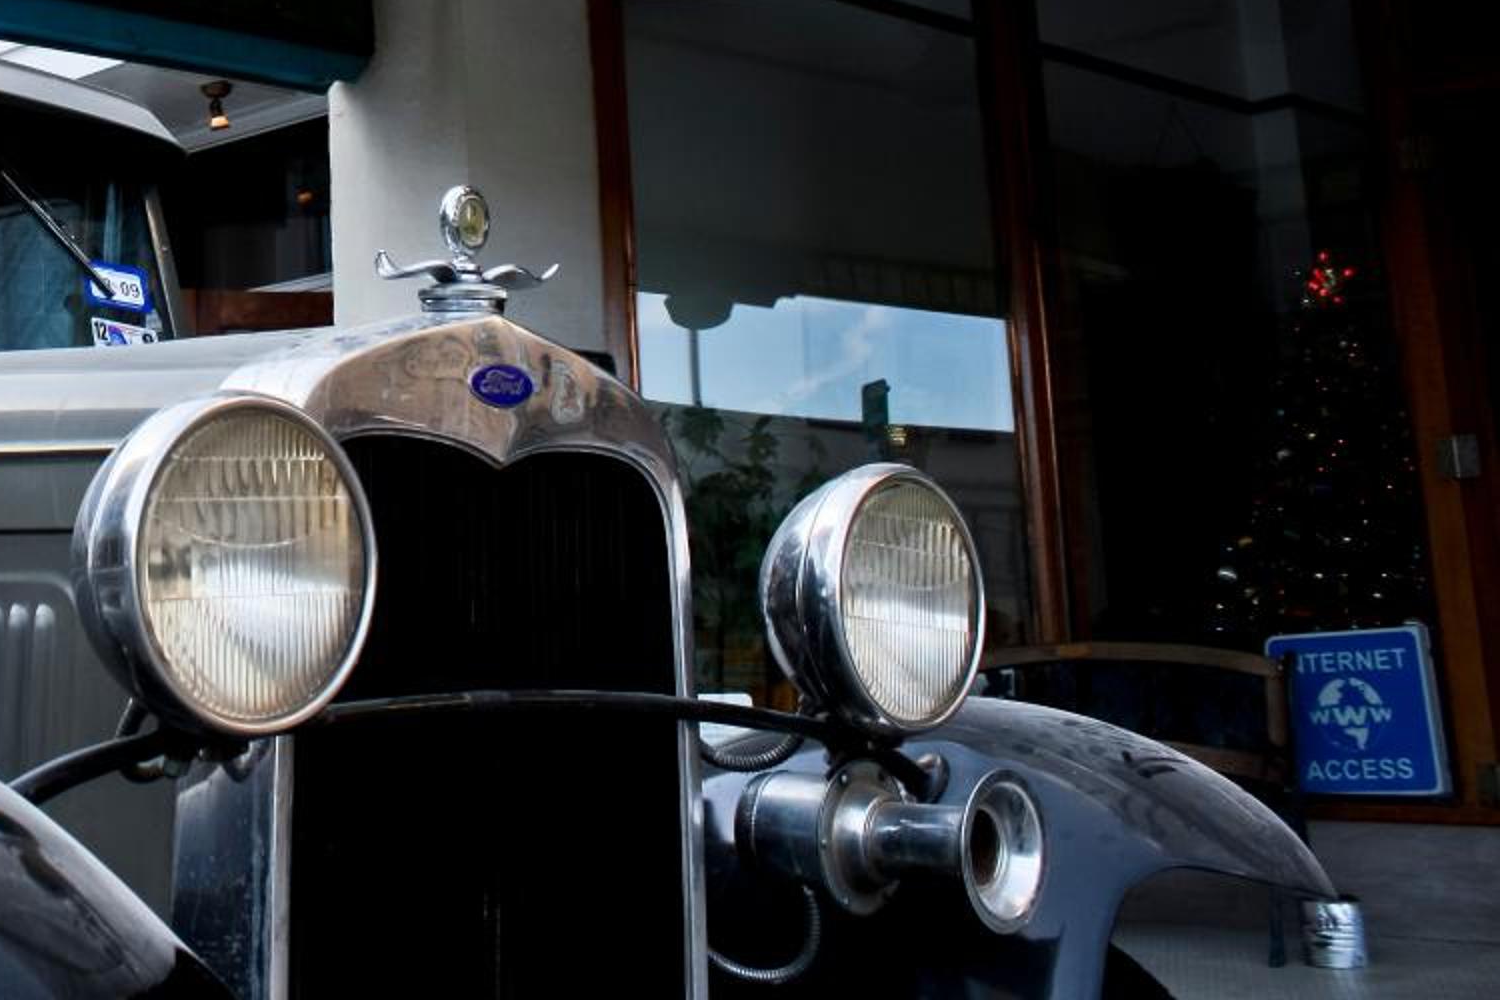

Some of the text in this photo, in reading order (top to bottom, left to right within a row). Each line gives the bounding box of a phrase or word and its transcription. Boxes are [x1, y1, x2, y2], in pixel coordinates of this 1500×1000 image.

[119, 281, 140, 298] 09
[480, 369, 525, 396] Ford
[1296, 648, 1406, 674] TERNET
[1306, 757, 1414, 781] ACCESS
